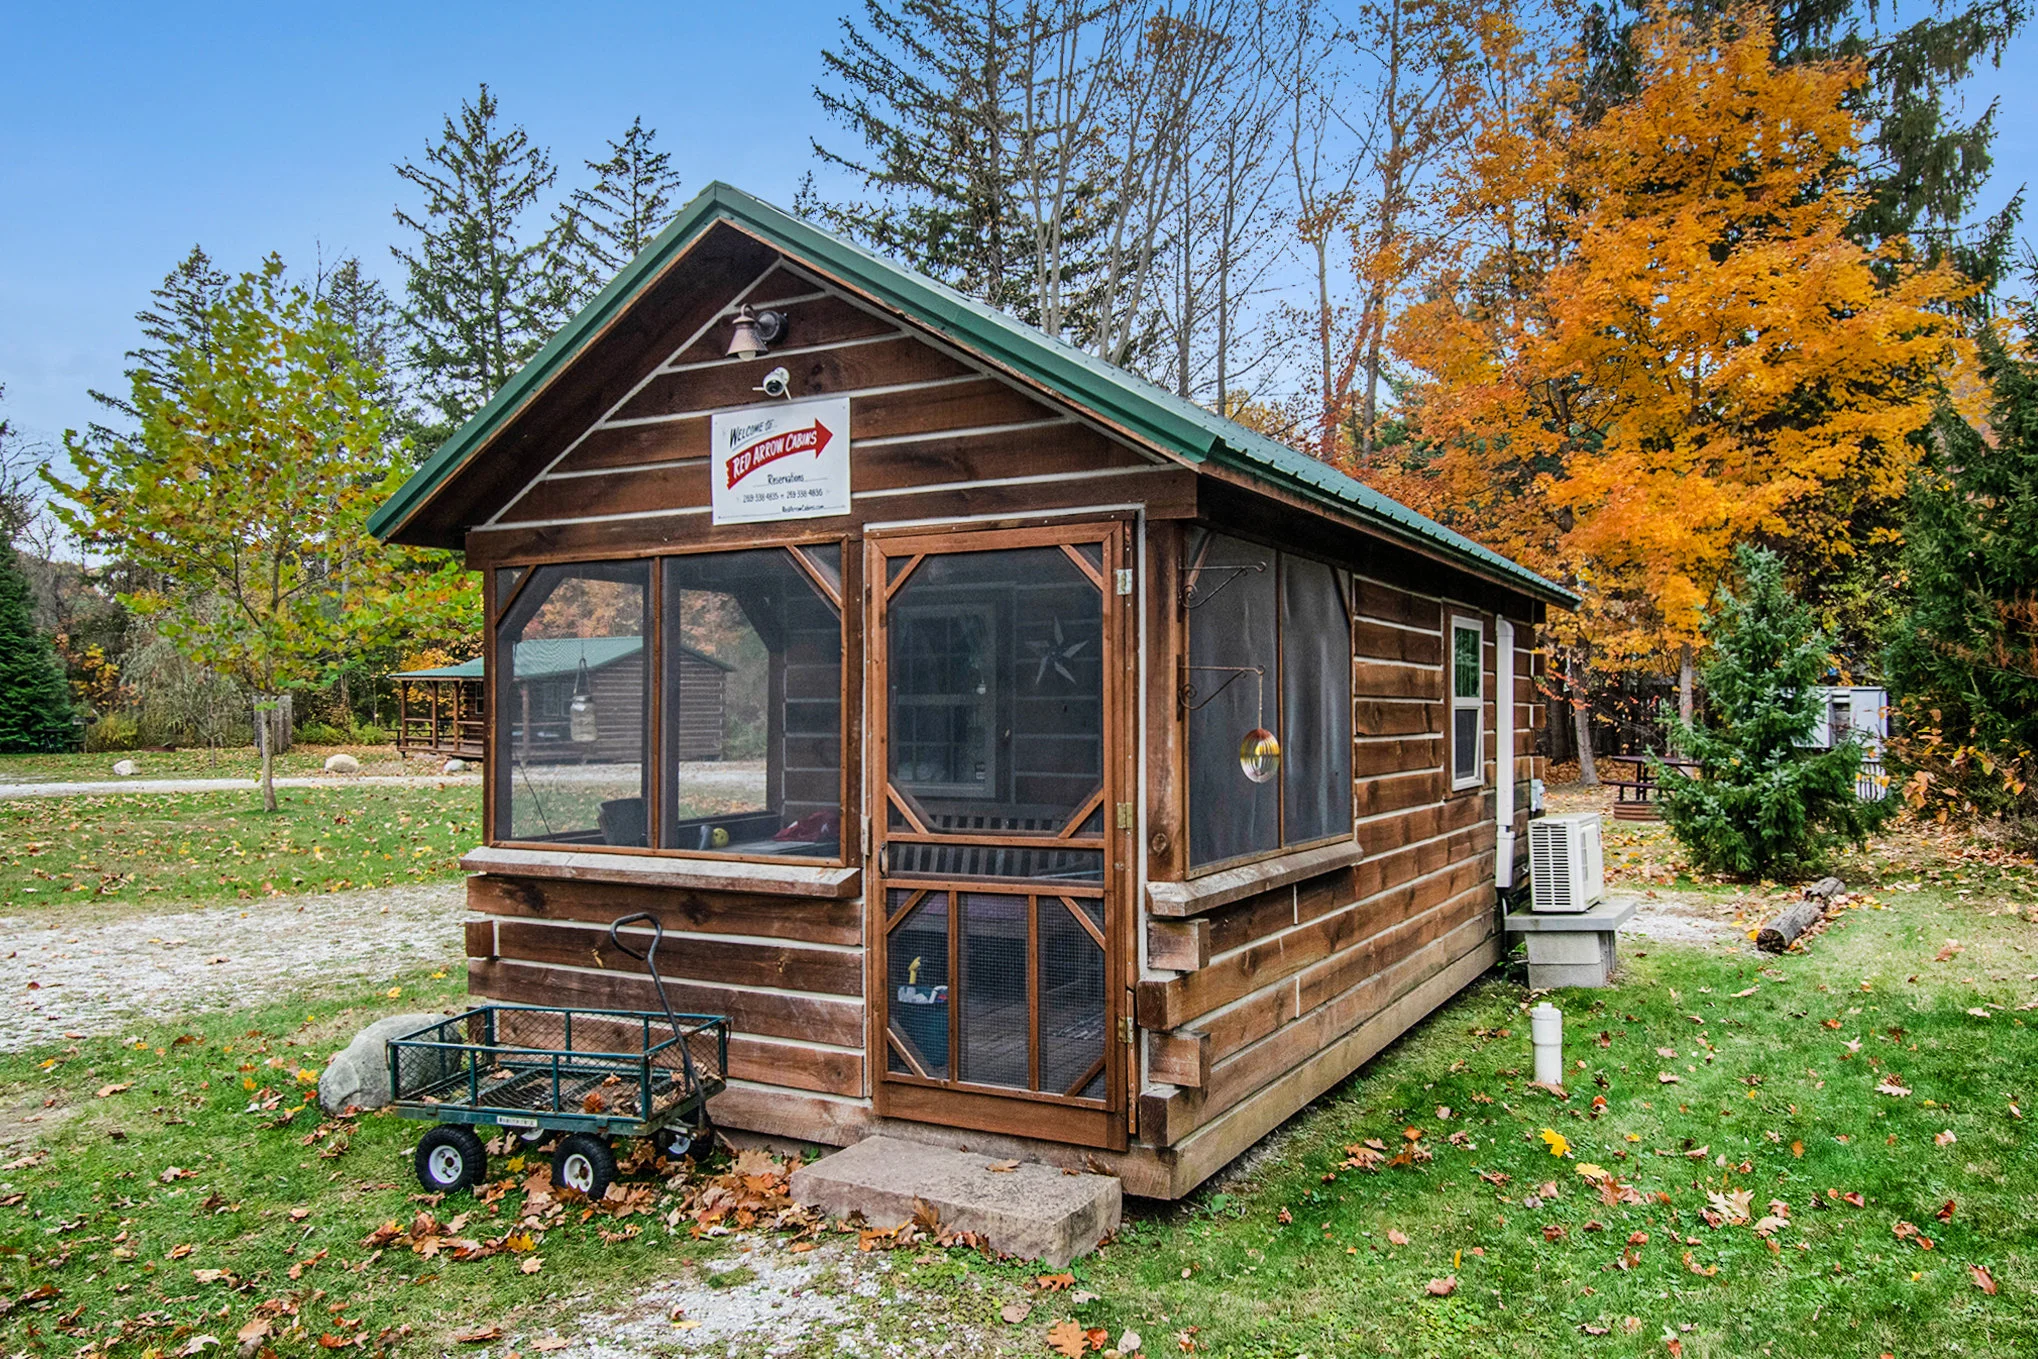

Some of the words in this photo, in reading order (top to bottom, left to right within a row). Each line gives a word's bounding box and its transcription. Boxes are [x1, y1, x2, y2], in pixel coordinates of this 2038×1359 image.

[729, 421, 764, 448] WELCOME
[732, 452, 752, 479] RED
[752, 437, 785, 465] ARROW
[785, 430, 818, 452] CABINS
[768, 473, 805, 486] Reservations
